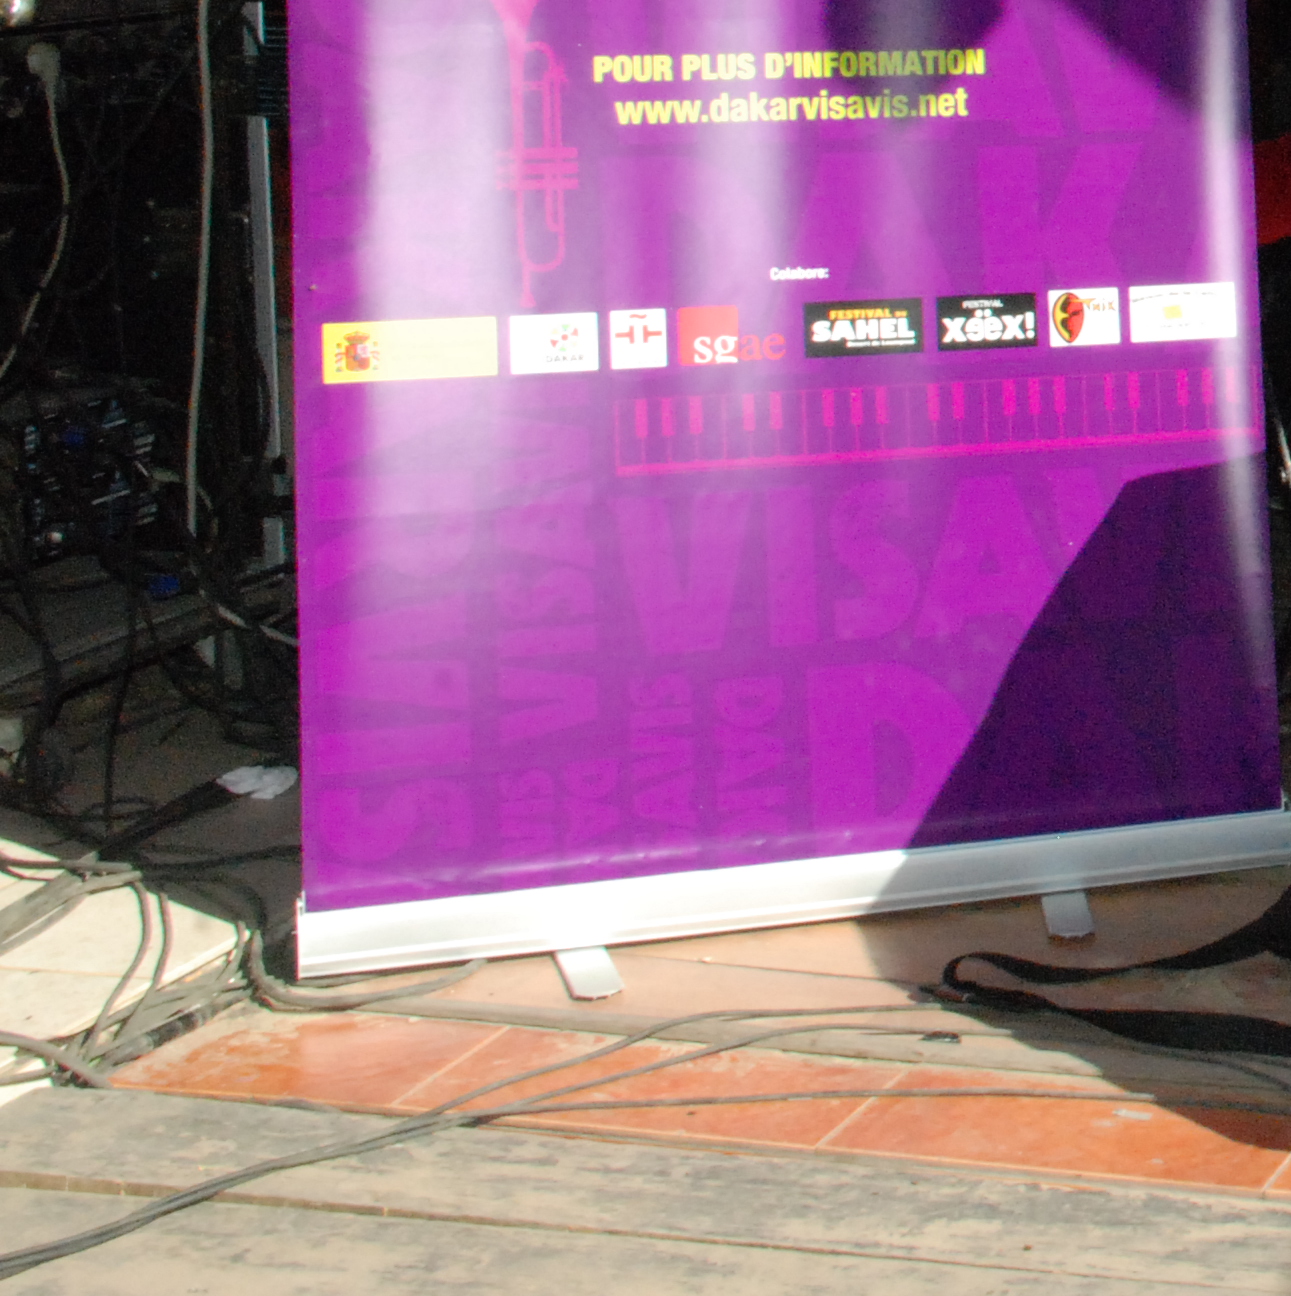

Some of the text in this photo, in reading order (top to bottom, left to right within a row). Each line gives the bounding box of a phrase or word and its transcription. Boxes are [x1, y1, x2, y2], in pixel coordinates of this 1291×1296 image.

[592, 48, 986, 84] POUR PLUS D'INFORMATION
[615, 89, 969, 125] www.dakarvisavis.net
[811, 318, 916, 343] SAHEL
[829, 308, 892, 320] FESTIVAL
[693, 332, 786, 365] sgae
